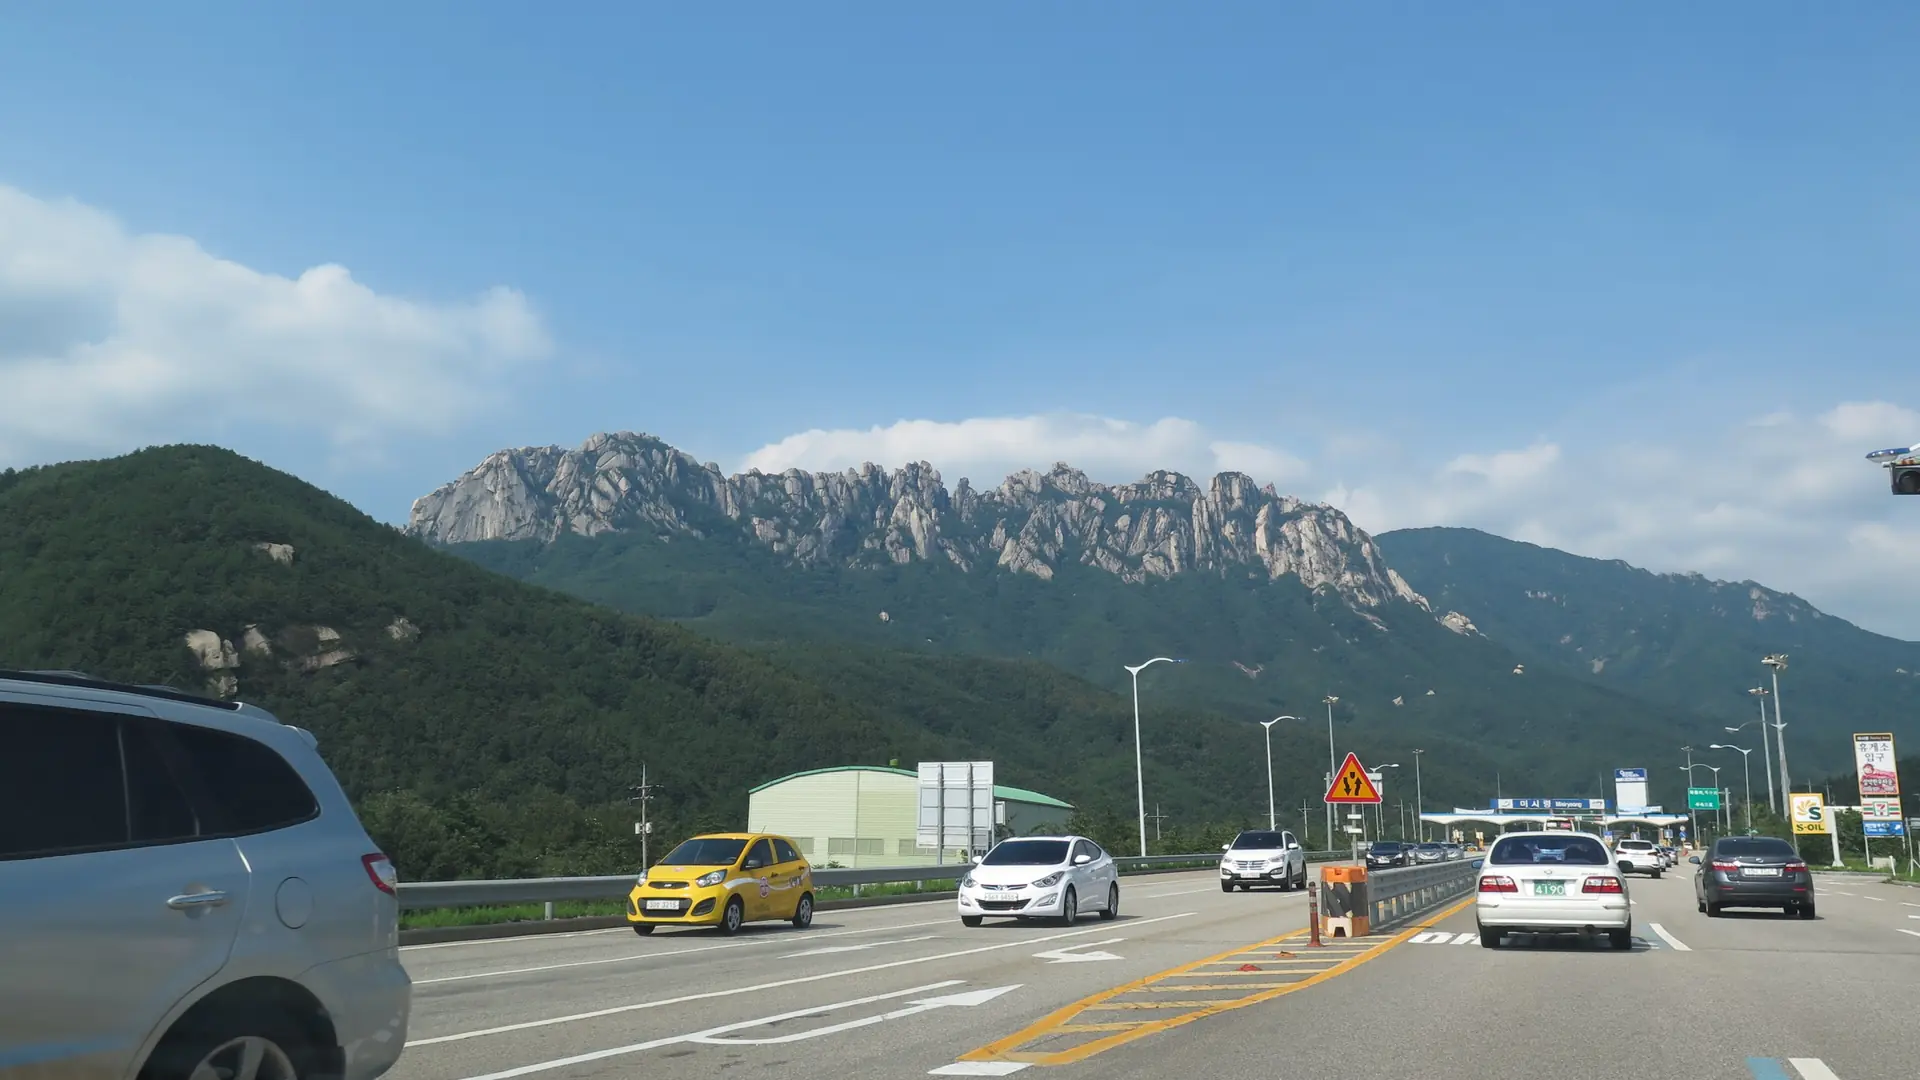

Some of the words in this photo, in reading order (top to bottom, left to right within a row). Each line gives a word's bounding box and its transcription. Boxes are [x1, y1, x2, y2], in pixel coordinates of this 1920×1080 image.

[1858, 743, 1890, 752] 휴게소
[1864, 752, 1885, 762] 입구
[1796, 823, 1825, 831] S-OIL
[1535, 884, 1565, 895] 4190
